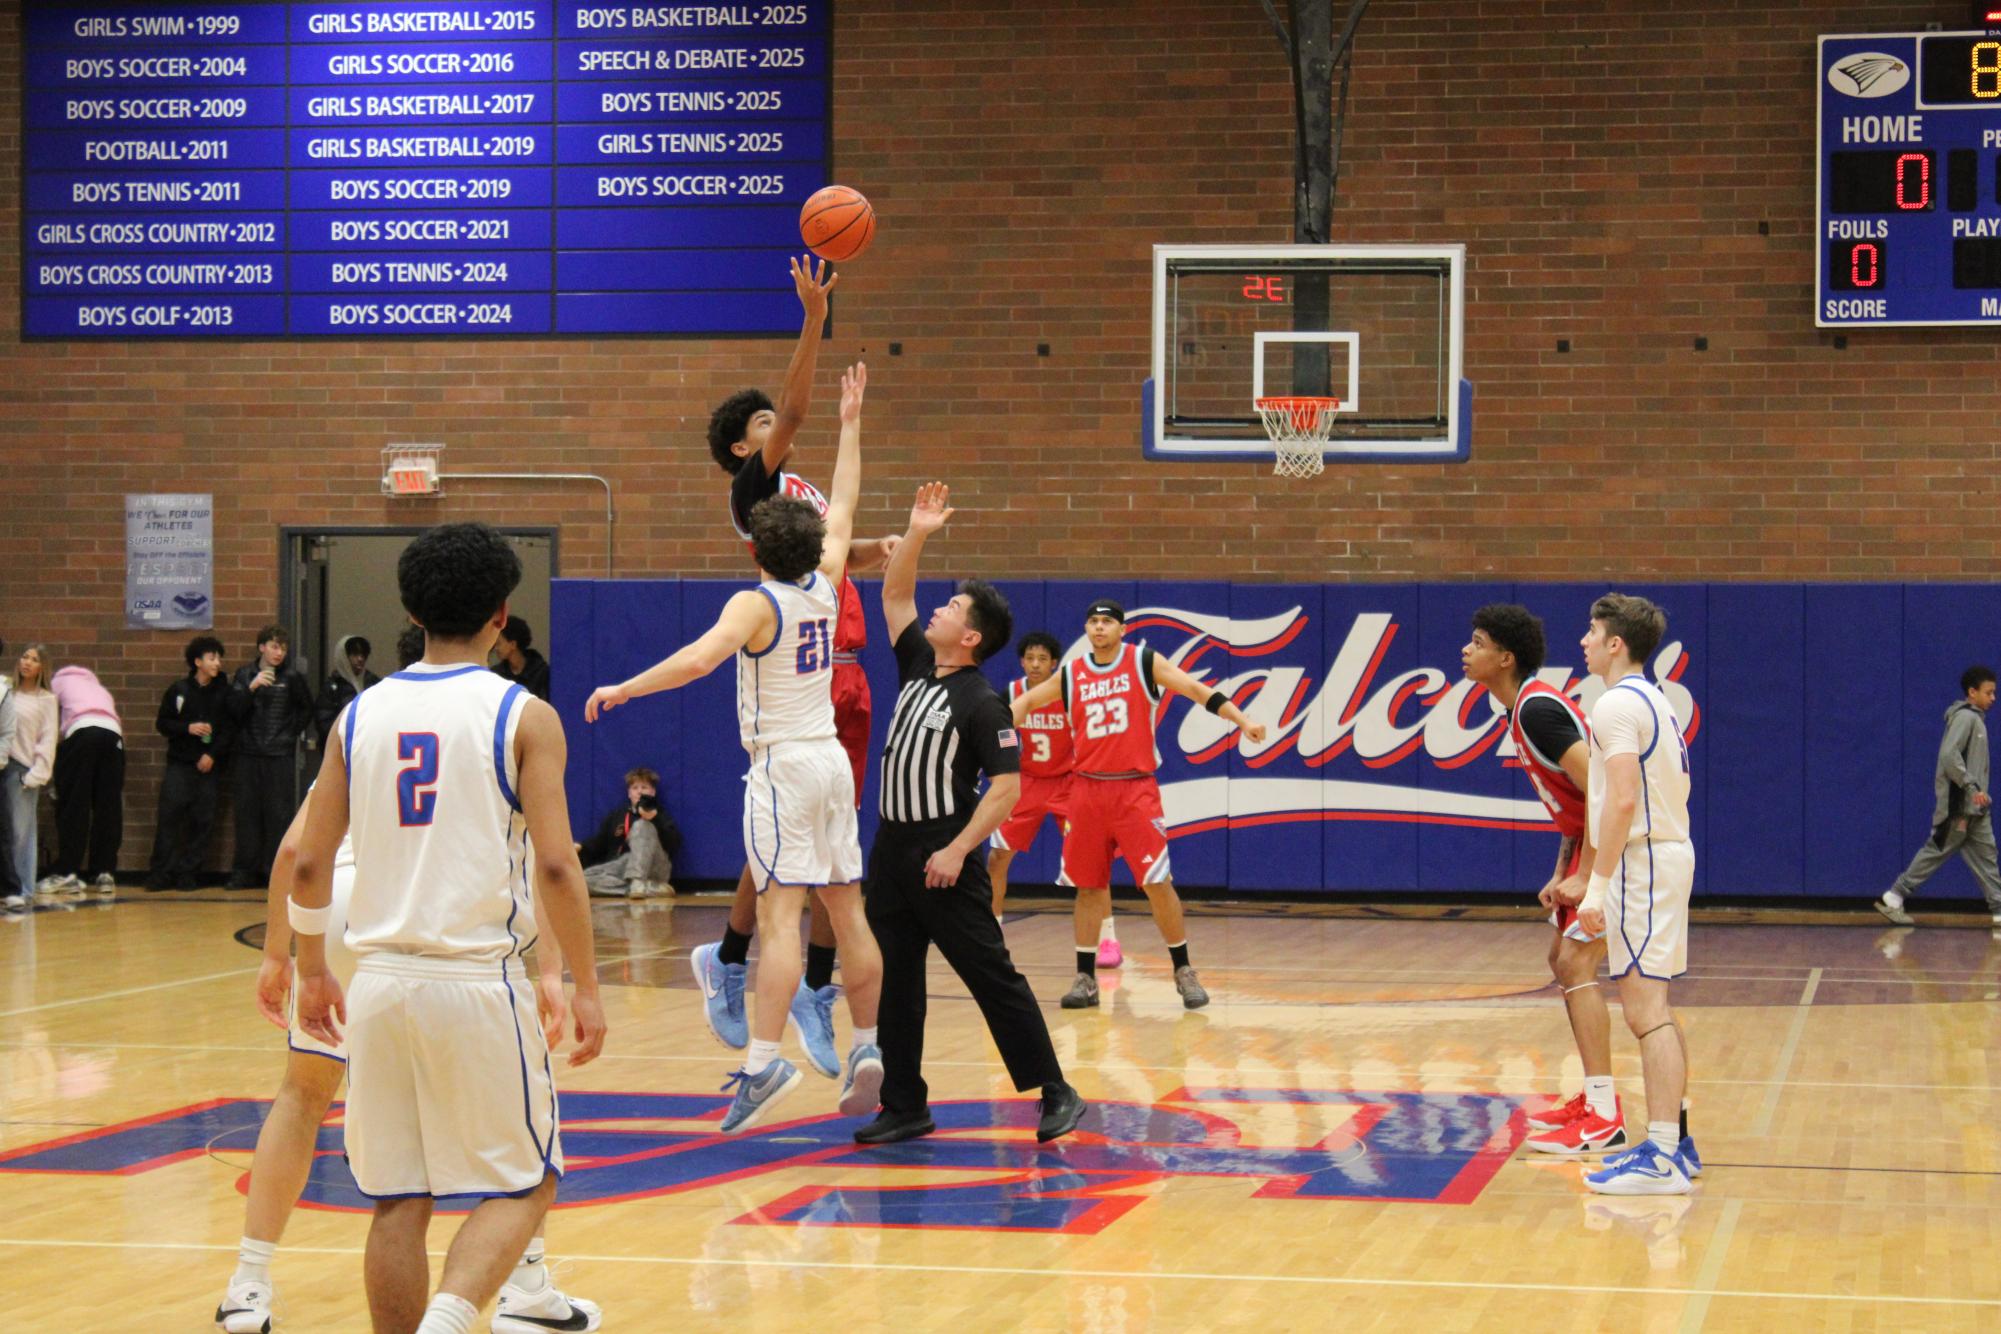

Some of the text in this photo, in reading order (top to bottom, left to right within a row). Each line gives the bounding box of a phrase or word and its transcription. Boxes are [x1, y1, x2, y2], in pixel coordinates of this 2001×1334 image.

[74, 16, 127, 37] GIRLS
[308, 12, 363, 34] GIRLS
[576, 8, 627, 29] BOYS
[65, 58, 115, 79] BOYS
[328, 54, 383, 76] GIRLS
[578, 50, 650, 71] SPEECH
[654, 49, 671, 70] &
[1971, 41, 2001, 97] 8
[65, 99, 115, 120] BOYS
[307, 96, 362, 117] GIRLS
[601, 92, 652, 113] BOYS
[1842, 115, 1923, 144] HOME
[307, 137, 362, 159] GIRLS
[597, 133, 654, 154] GIRLS
[330, 179, 380, 200] BOYS
[597, 176, 648, 197] BOYS
[1896, 153, 1929, 209] 0
[72, 182, 121, 203] BOYS
[37, 223, 86, 244] GIRLS
[89, 223, 144, 244] CROSS
[331, 220, 381, 241] BOYS
[1828, 219, 1889, 239] FOULS
[39, 265, 83, 285] BOYS
[87, 264, 142, 285] CROSS
[332, 262, 382, 283] BOYS
[1852, 243, 1878, 287] 0
[78, 306, 127, 327] BOYS
[329, 304, 380, 325] BOYS
[1826, 299, 1888, 319] SCORE
[168, 510, 189, 519] FOR
[190, 510, 210, 519] OUR
[144, 521, 193, 530] ATHLETES
[128, 536, 176, 545] SUPPORT
[136, 576, 203, 585] OUR OPPONENT
[796, 618, 830, 675] 21
[1079, 673, 1131, 702] EAGLES
[1019, 714, 1064, 730] AGLES
[1085, 697, 1129, 740] 23
[1030, 733, 1052, 763] 3
[396, 731, 440, 828] 2
